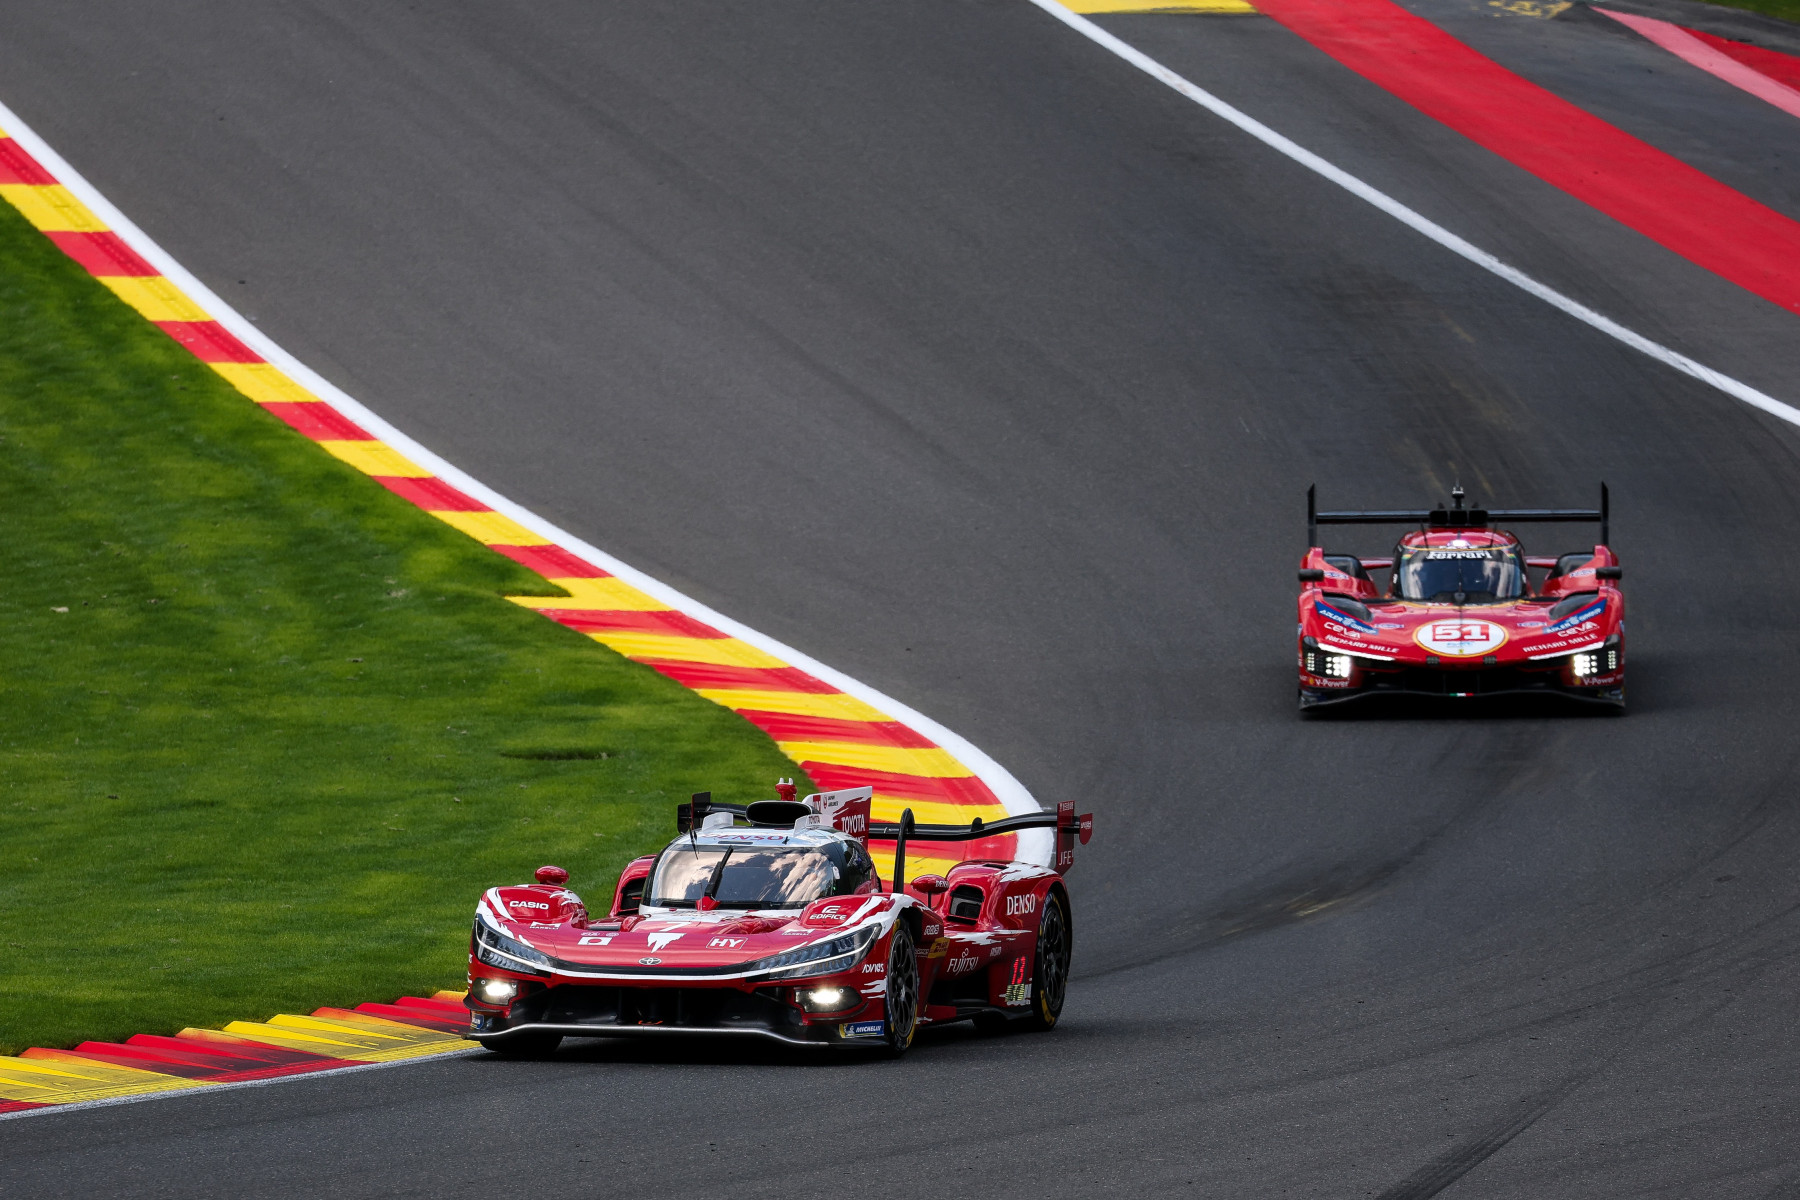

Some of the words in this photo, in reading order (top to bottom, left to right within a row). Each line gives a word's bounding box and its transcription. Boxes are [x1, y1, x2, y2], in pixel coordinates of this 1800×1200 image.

[1426, 550, 1492, 559] Ferrari
[1434, 624, 1487, 640] 51
[1325, 634, 1367, 648] RICHARD
[1368, 644, 1399, 653] MILLE
[1523, 640, 1567, 652] RICHARD
[1568, 633, 1598, 645] MILLE
[1315, 678, 1350, 687] V-Power
[1583, 677, 1615, 686] V-Power
[841, 814, 866, 834] TOYOTA
[509, 900, 549, 910] CASIO
[1006, 894, 1036, 915] DENSO
[809, 913, 848, 921] EDIFICE
[709, 938, 744, 948] HY
[946, 956, 979, 976] FUJITSU
[855, 1025, 882, 1033] MICHELIN
